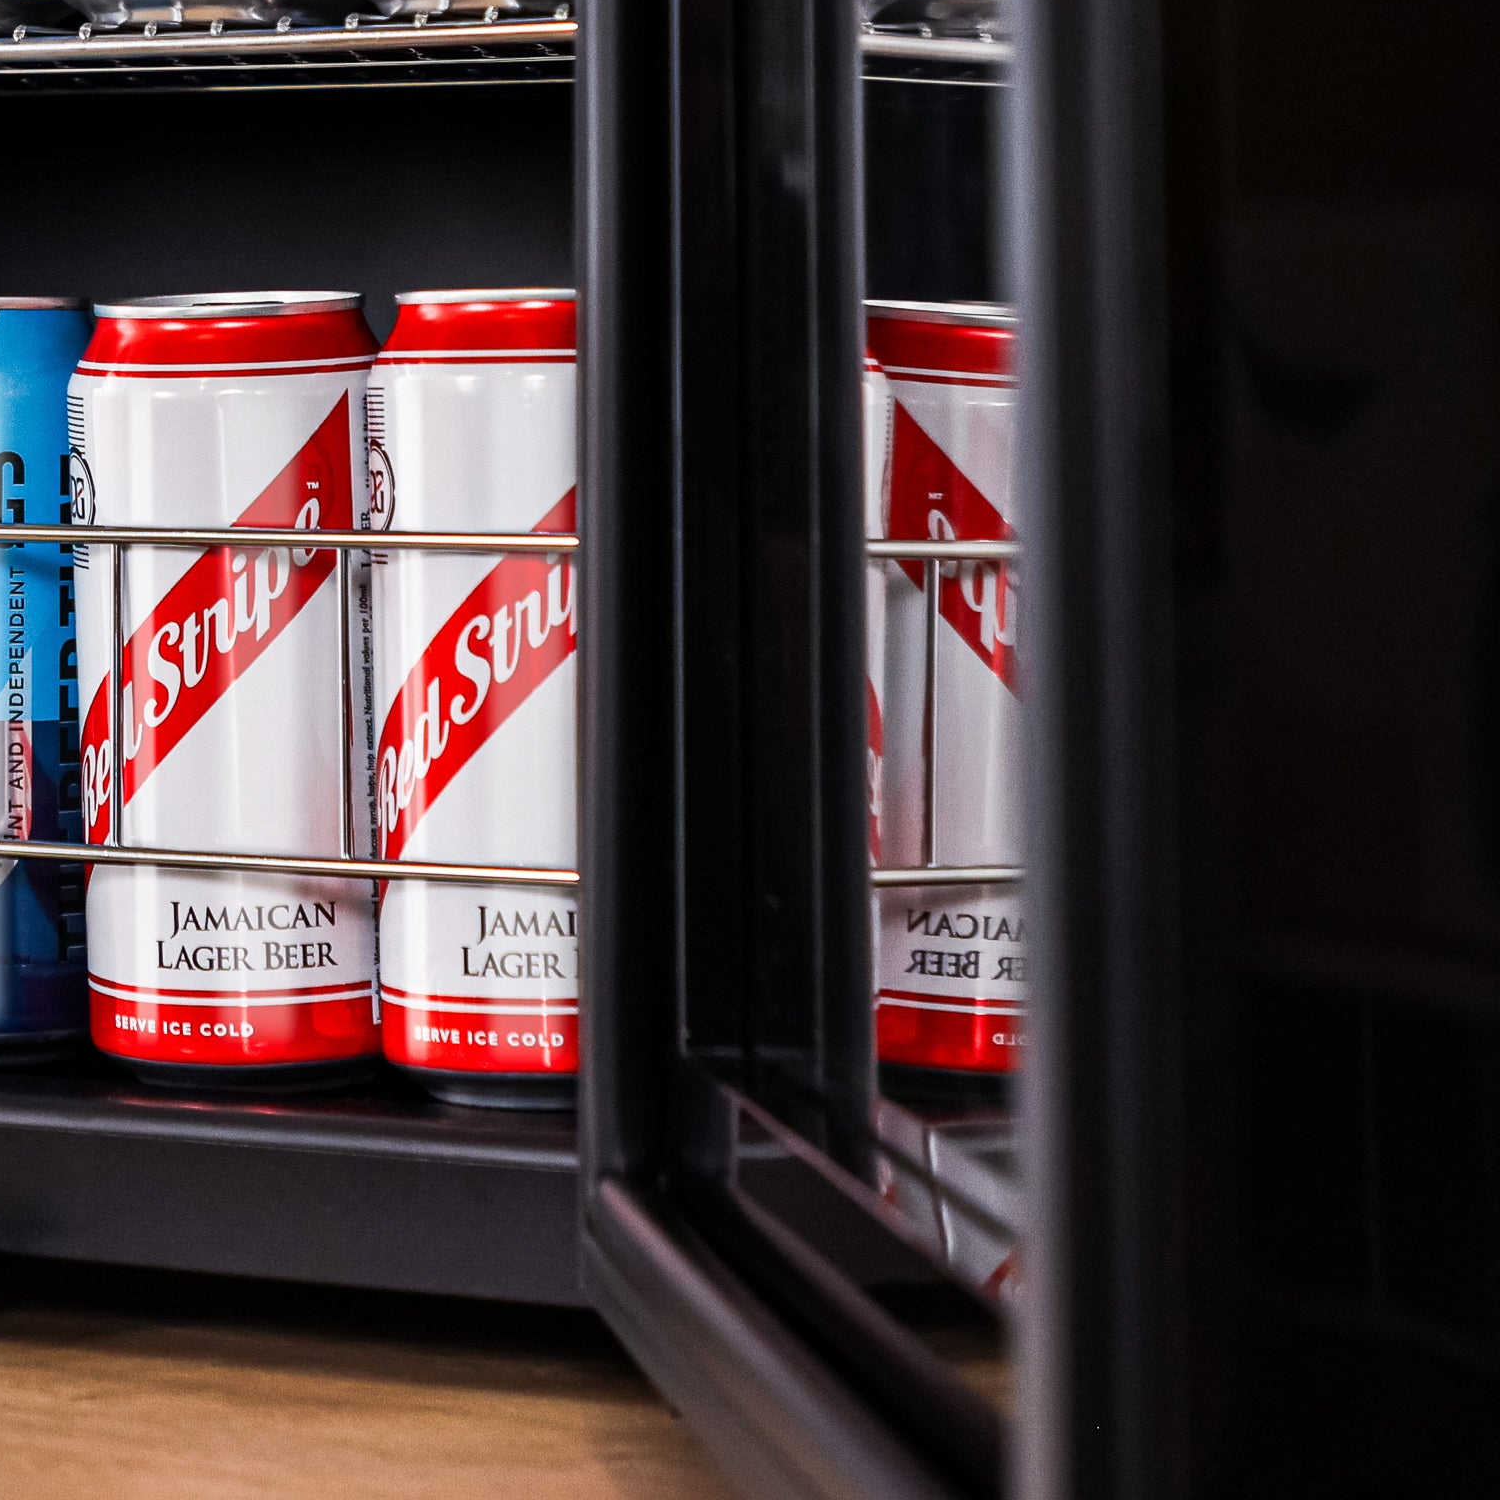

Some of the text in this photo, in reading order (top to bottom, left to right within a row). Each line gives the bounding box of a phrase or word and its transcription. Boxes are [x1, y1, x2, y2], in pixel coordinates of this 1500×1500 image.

[143, 497, 321, 728] Stripe
[361, 617, 372, 633] per
[8, 566, 25, 731] INDEPENDENT
[360, 637, 370, 664] values
[361, 667, 373, 715] Nutritional
[379, 553, 576, 833] Red Stri
[8, 741, 24, 790] AND
[369, 828, 378, 859] lucose
[170, 901, 337, 939] JAMAICAN
[477, 905, 577, 945] JAMAI
[155, 941, 339, 972] LAGER BEER
[462, 947, 566, 979] LAGER
[115, 1014, 255, 1038] SERVE ICE COLD
[414, 1026, 564, 1047] SERVE ICE COLD
